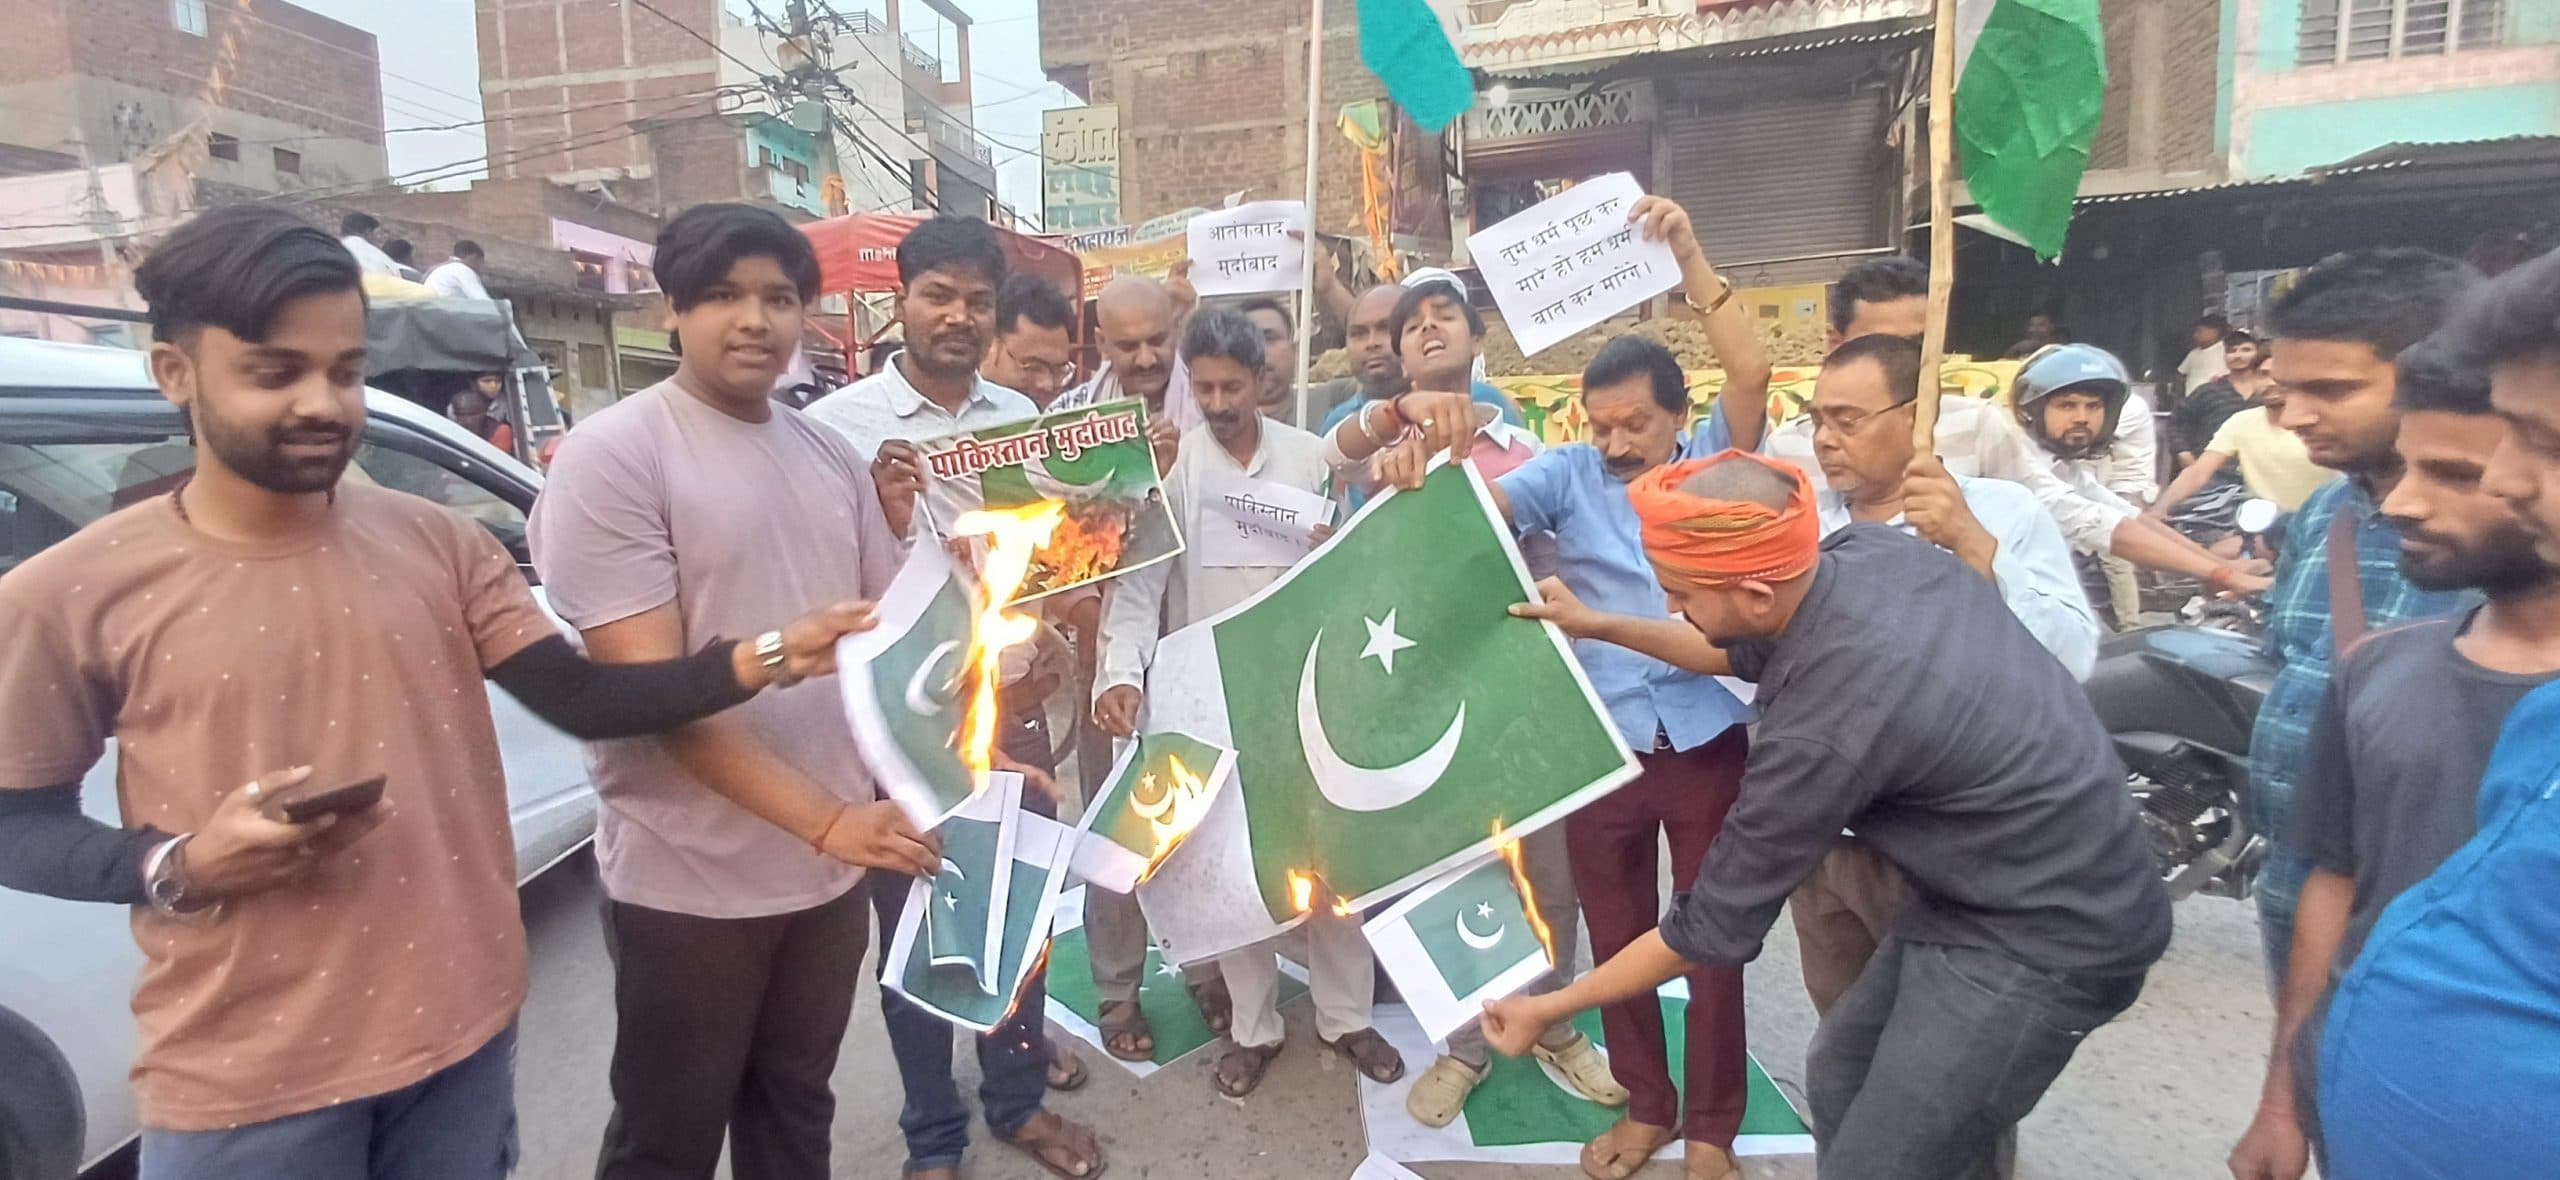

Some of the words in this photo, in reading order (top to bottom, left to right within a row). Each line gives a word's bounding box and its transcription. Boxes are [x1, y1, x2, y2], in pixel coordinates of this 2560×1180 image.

[1208, 220, 1284, 240] आतंकवाद
[1500, 240, 1529, 266] तुम
[1532, 221, 1561, 247] धर्म
[1595, 197, 1619, 216] कर
[1217, 252, 1279, 280] मुर्दाबाद
[1515, 267, 1547, 293] मारे
[1552, 255, 1574, 279] हो
[1576, 241, 1605, 266] हम
[1606, 223, 1633, 250] धर्म
[1569, 284, 1596, 307] कर
[928, 430, 1049, 480] पाकिस्तान
[1053, 412, 1138, 461] मुर्दाबाद
[1224, 493, 1300, 525] पाकिस्तान
